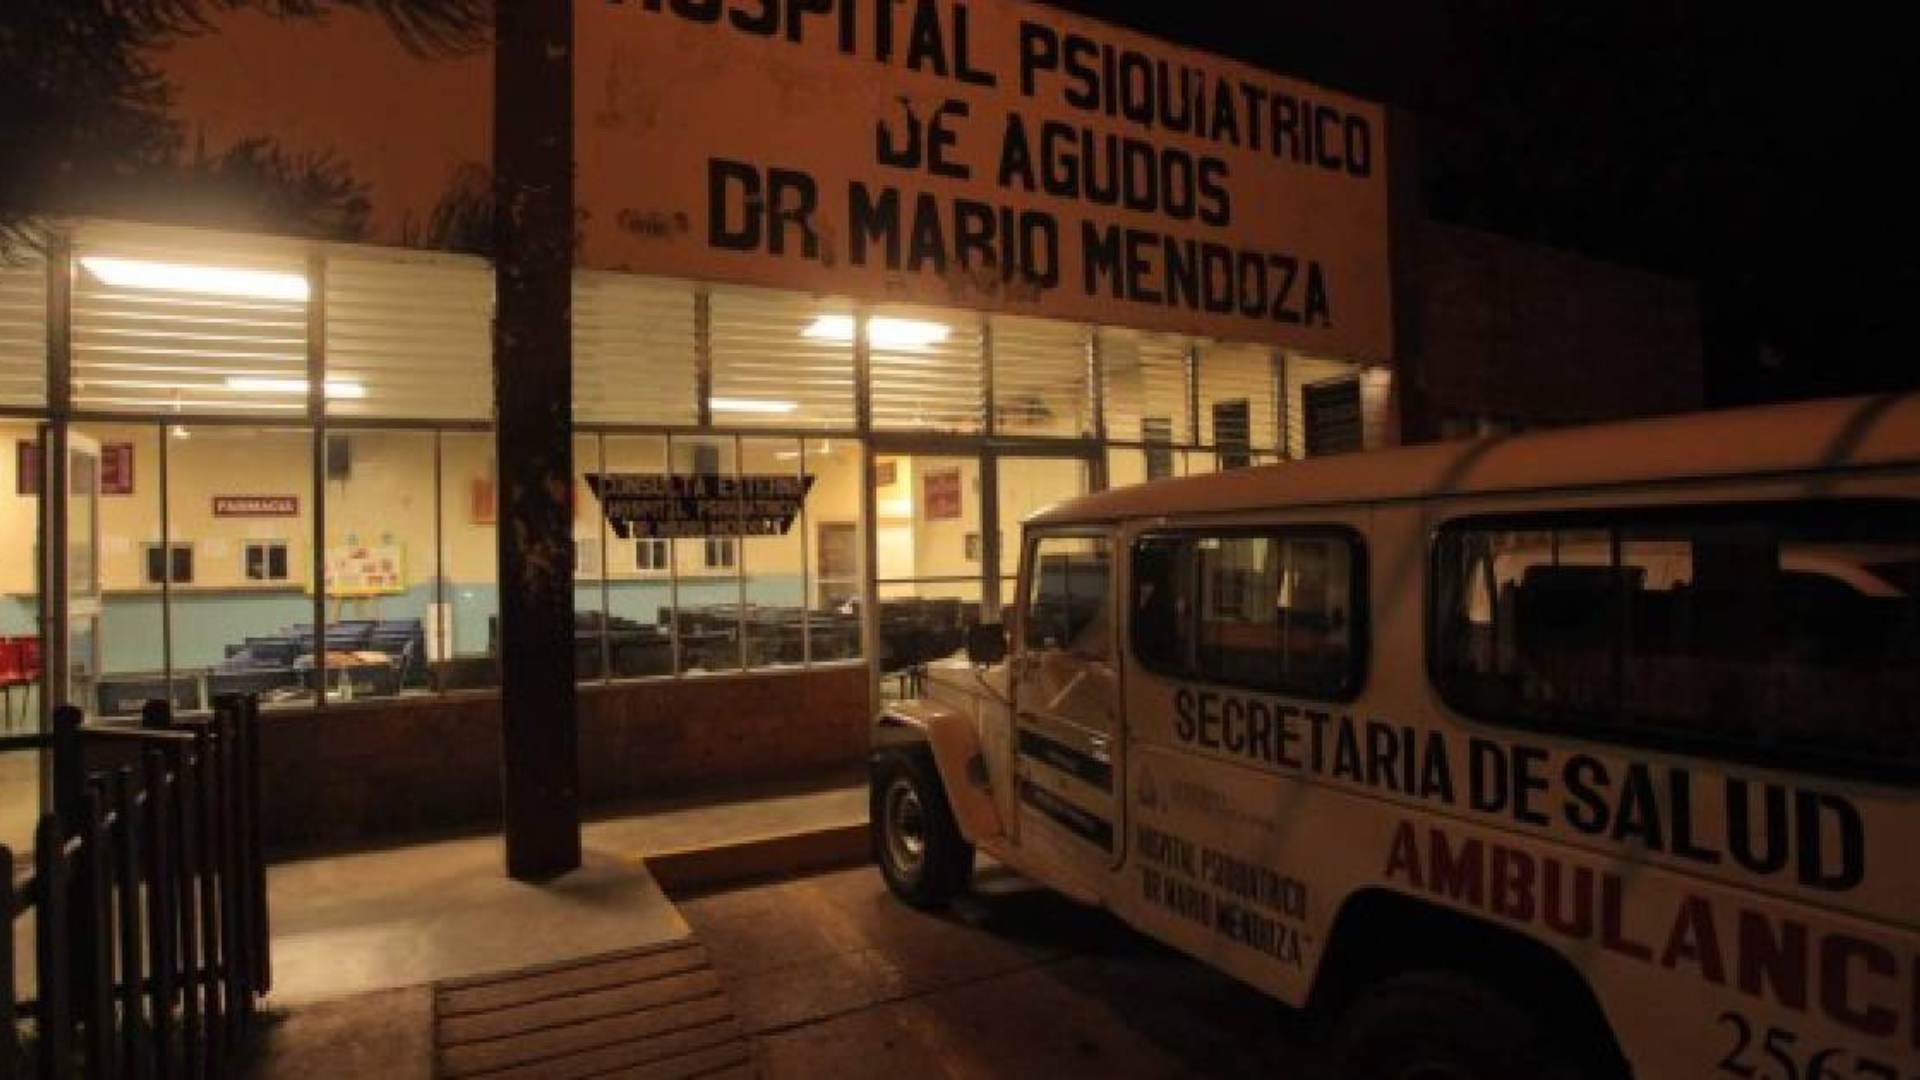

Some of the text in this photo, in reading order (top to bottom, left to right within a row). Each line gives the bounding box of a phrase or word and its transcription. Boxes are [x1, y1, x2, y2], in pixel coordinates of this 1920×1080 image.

[605, 0, 997, 86] PITAL
[876, 97, 1231, 227] DE AGUDOS
[849, 180, 1058, 290] MARIO
[1082, 219, 1331, 328] MENDOZA
[1175, 687, 1455, 803] SECRETARIA
[1468, 737, 1552, 827] DE
[1563, 754, 1865, 893] SALUD
[1385, 819, 1920, 1052] AMBULANC
[1717, 1012, 1898, 1080] 25
